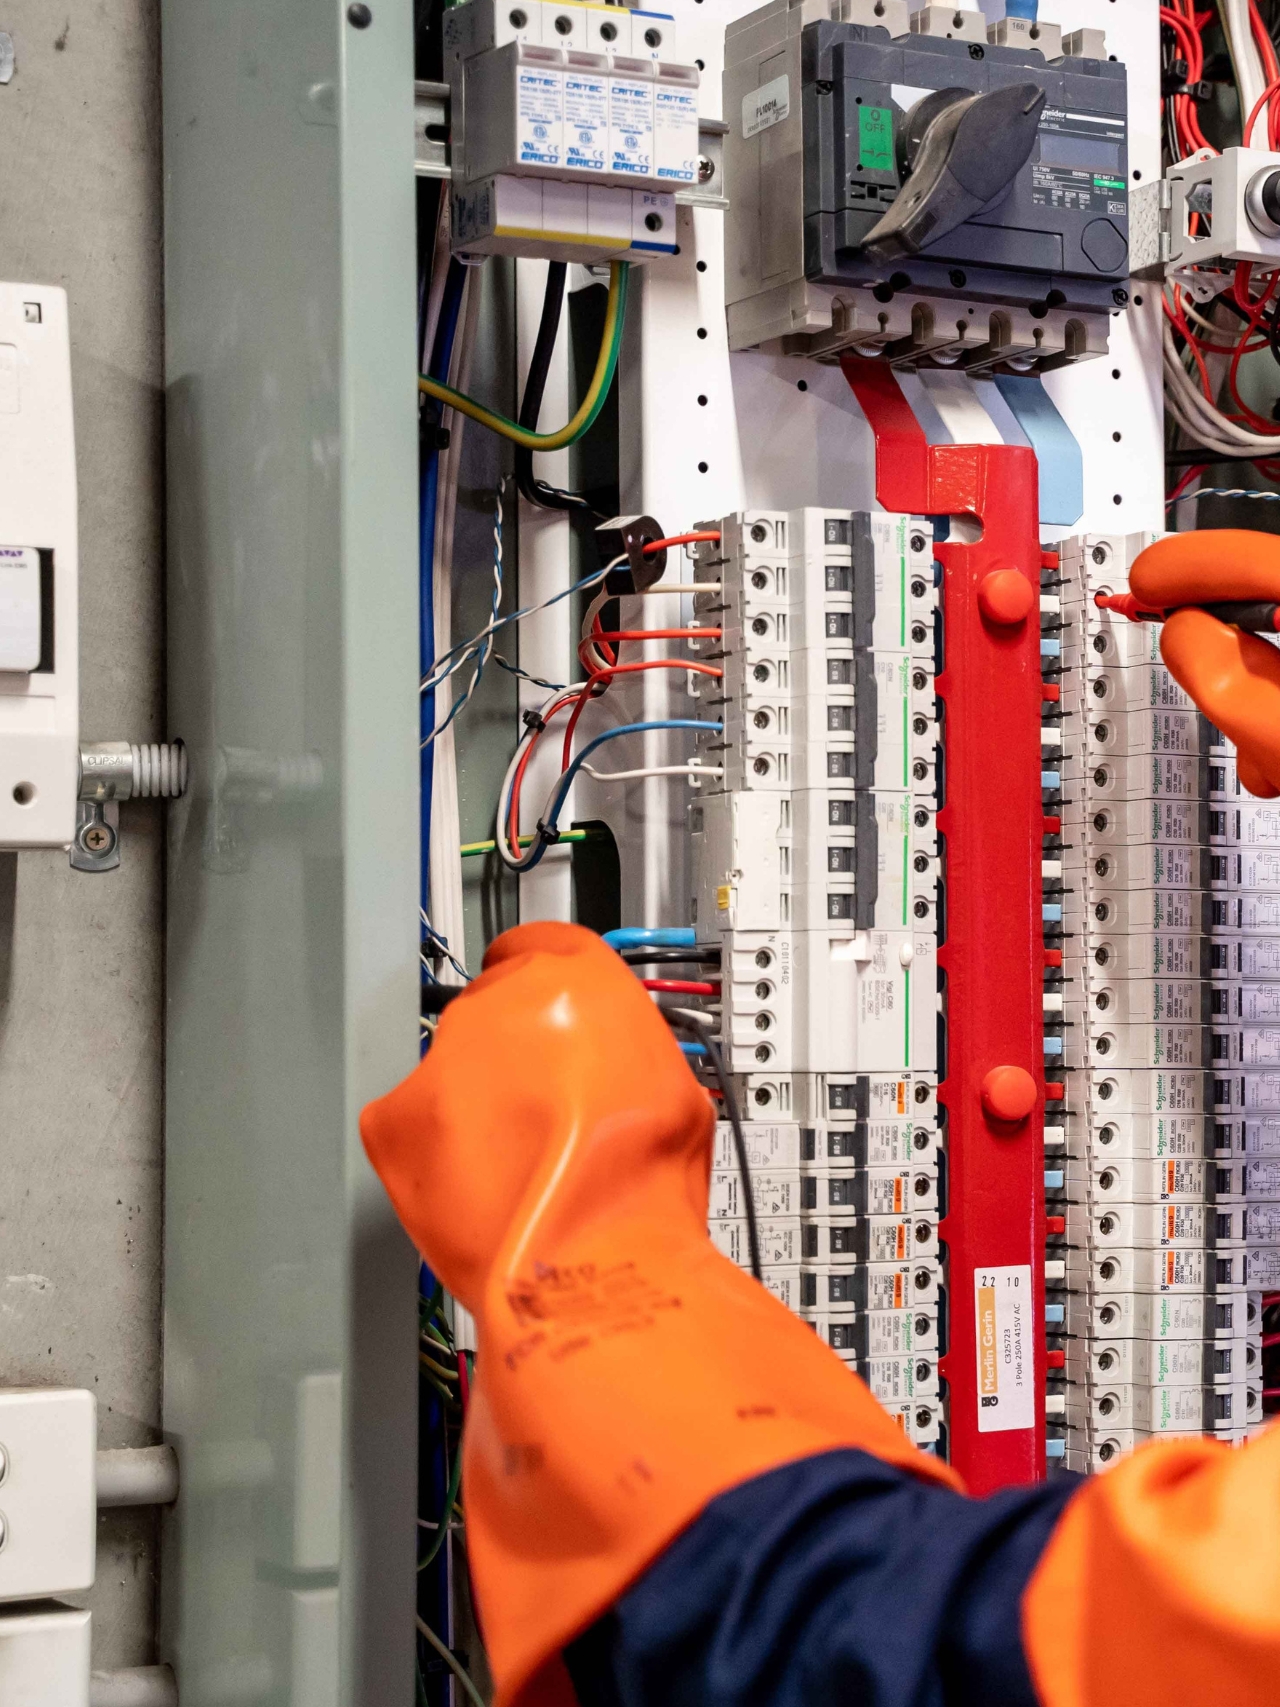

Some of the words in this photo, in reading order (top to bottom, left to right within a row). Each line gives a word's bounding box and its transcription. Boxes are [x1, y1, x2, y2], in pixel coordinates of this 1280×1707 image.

[1012, 22, 1025, 31] 160
[520, 76, 557, 87] CRITEC
[566, 82, 602, 93] CRITEC
[611, 87, 648, 98] CRITEC
[656, 93, 692, 104] CRITEC
[865, 121, 885, 133] OFF
[521, 152, 558, 164] ERICO
[566, 157, 603, 169] ERICO
[612, 162, 649, 174] ERICO
[657, 168, 693, 180] ERICO
[644, 196, 657, 206] PE
[897, 516, 908, 557] Schneider
[1151, 624, 1161, 661] Schneider
[899, 656, 910, 696] Schneider
[1150, 669, 1161, 706] Schneider
[1152, 713, 1162, 750] Schneider
[88, 756, 125, 766] CLIPSAL
[1152, 757, 1162, 794] Schneider
[901, 795, 911, 834] Schneider
[1152, 802, 1162, 839] Schneider
[1153, 847, 1164, 884] Schneider
[1154, 892, 1164, 929] Schneider
[1154, 937, 1164, 974] Schneider
[1153, 983, 1163, 1020] Schneider
[1154, 1028, 1164, 1065] Schneider
[1156, 1074, 1166, 1111] Schneider
[902, 1122, 912, 1161] Schneider
[1157, 1119, 1167, 1156] Schneider
[1013, 1303, 1021, 1315] AC
[1160, 1298, 1170, 1336] Schneider
[902, 1313, 912, 1352] Schneider
[982, 1310, 994, 1347] Gerin
[1004, 1328, 1012, 1364] C325723
[1014, 1339, 1022, 1360] 250A
[1158, 1344, 1168, 1382] Schneider
[904, 1357, 914, 1397] Schneider
[983, 1350, 996, 1391] Merlin
[1015, 1362, 1023, 1380] Pole
[1160, 1389, 1171, 1428] Schneider
